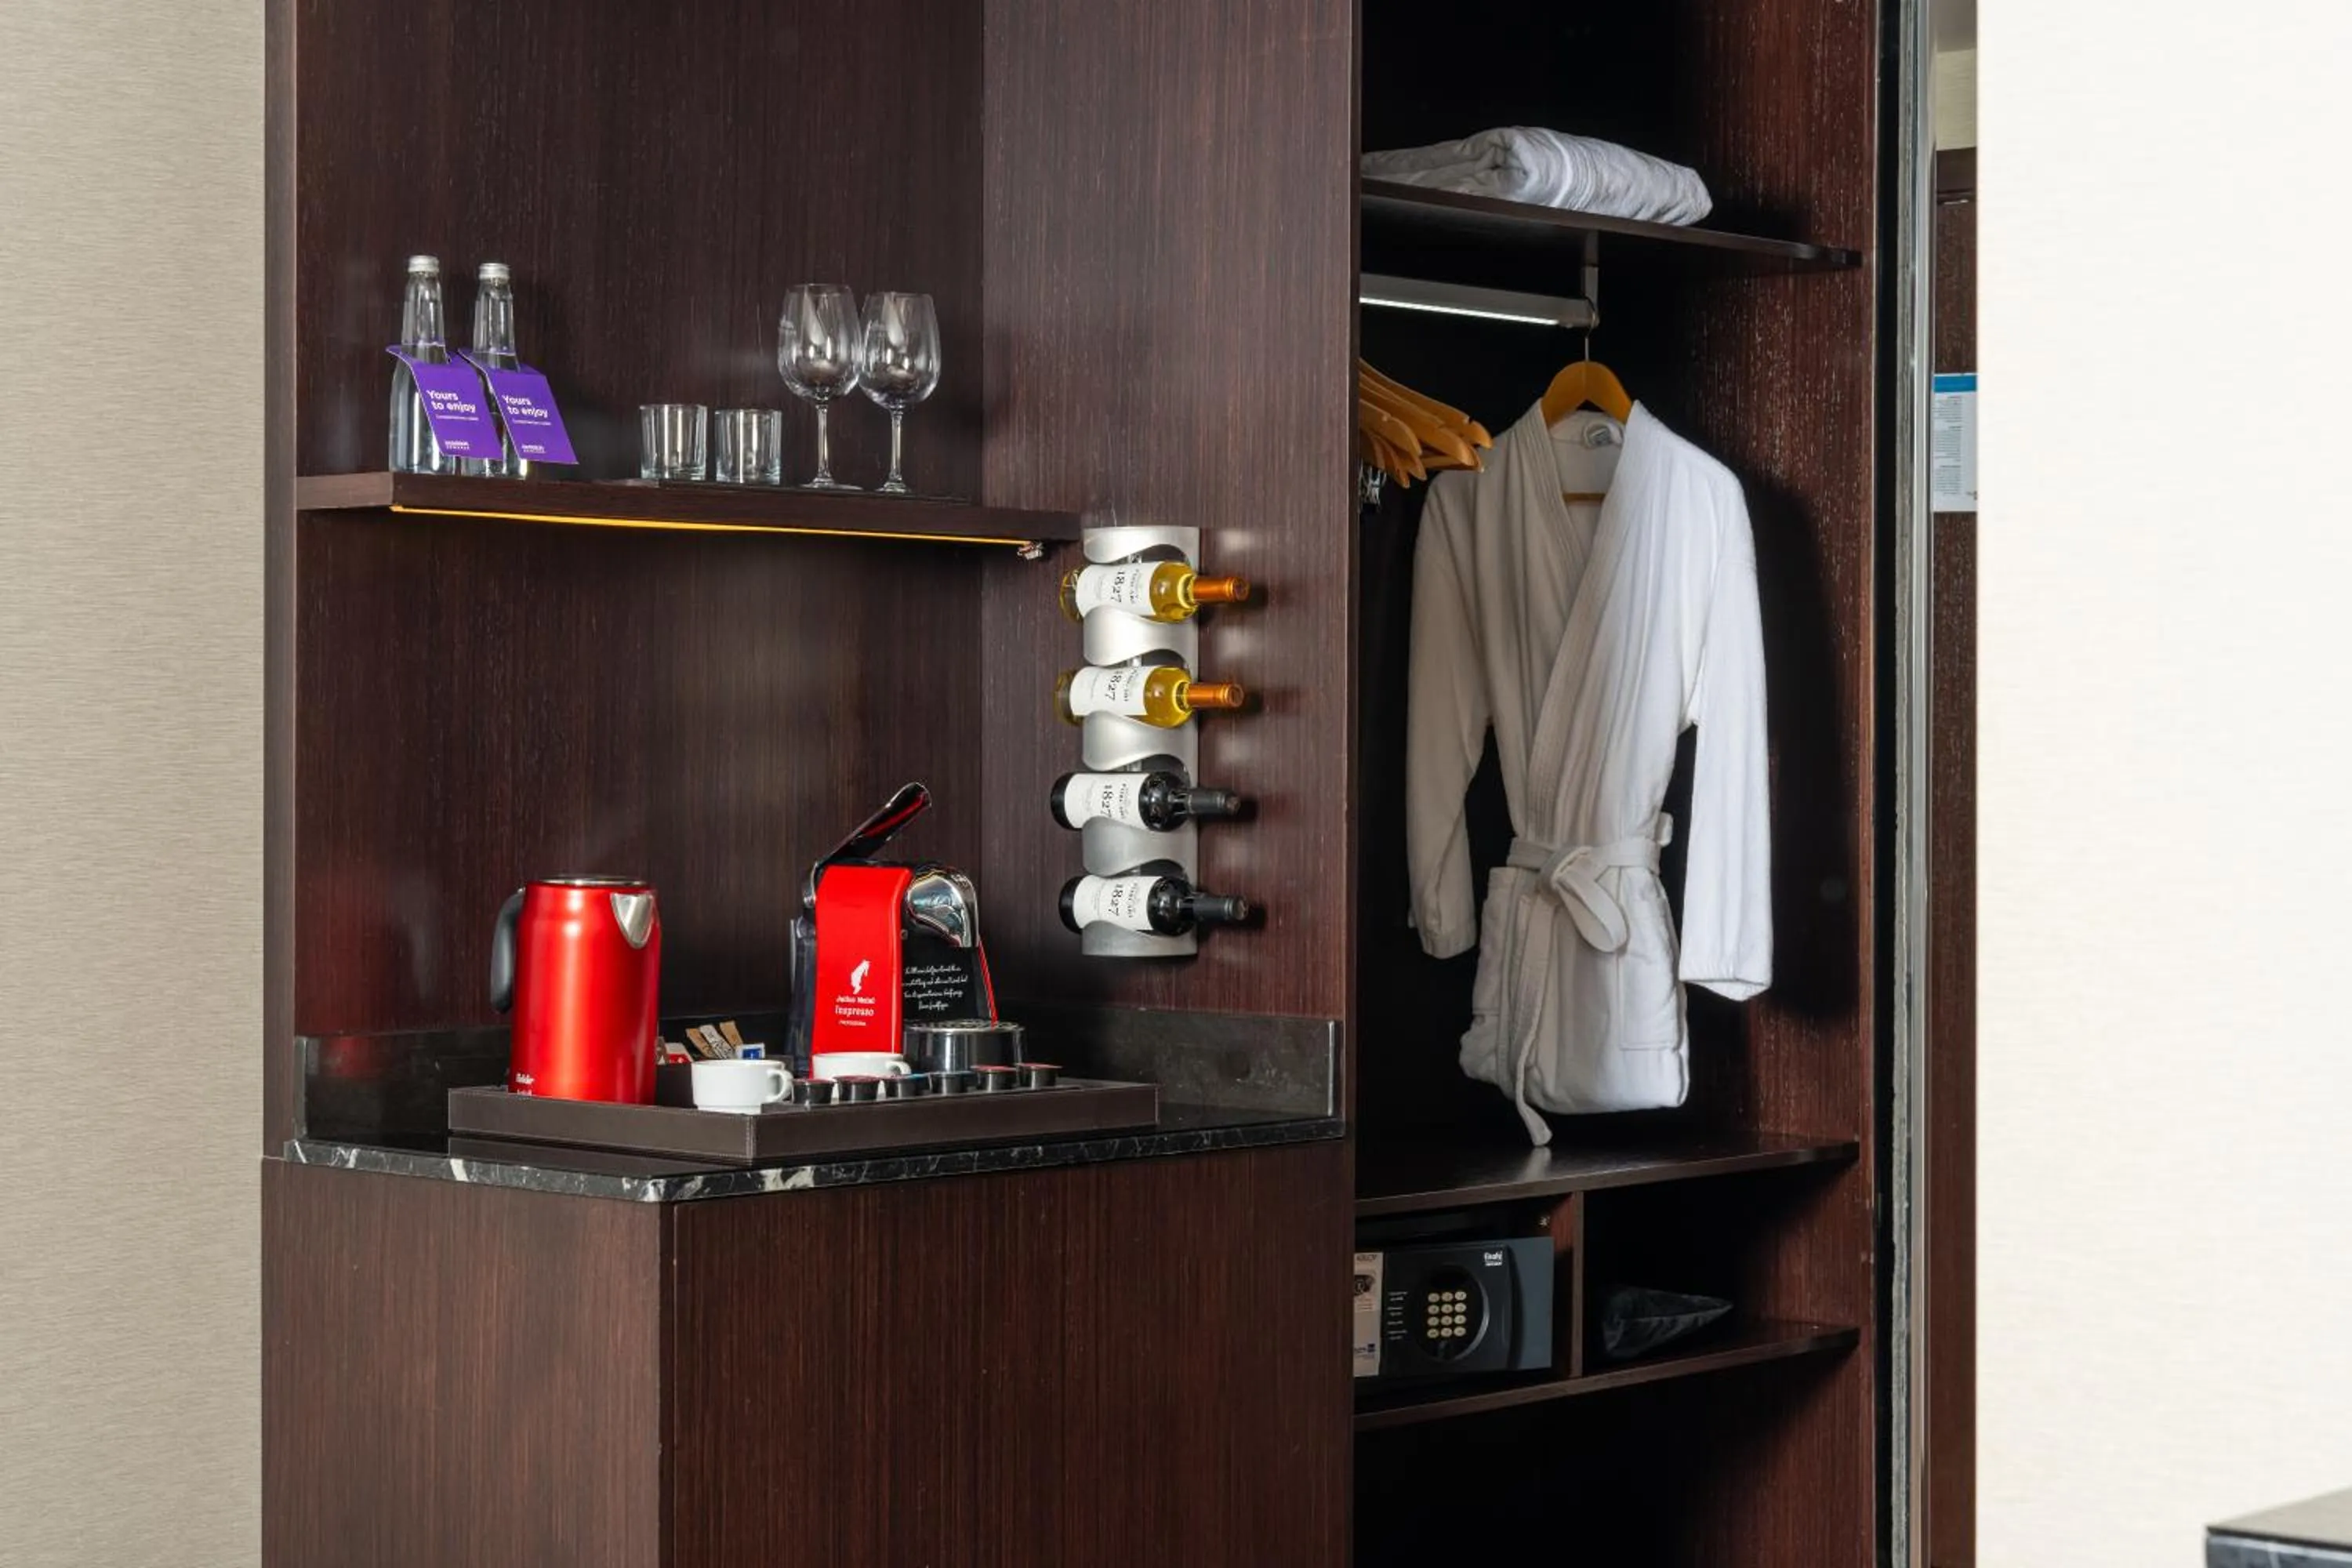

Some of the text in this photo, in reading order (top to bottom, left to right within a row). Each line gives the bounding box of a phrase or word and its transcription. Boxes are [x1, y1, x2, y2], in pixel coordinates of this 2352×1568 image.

[426, 390, 459, 401] Yours
[502, 394, 532, 405] Yours
[431, 401, 476, 413] to enjoy
[507, 406, 548, 418] to enjoy
[1110, 571, 1125, 603] 1827
[1105, 670, 1123, 701] 1827
[1100, 785, 1113, 818] 1827
[1108, 884, 1123, 916] 1827
